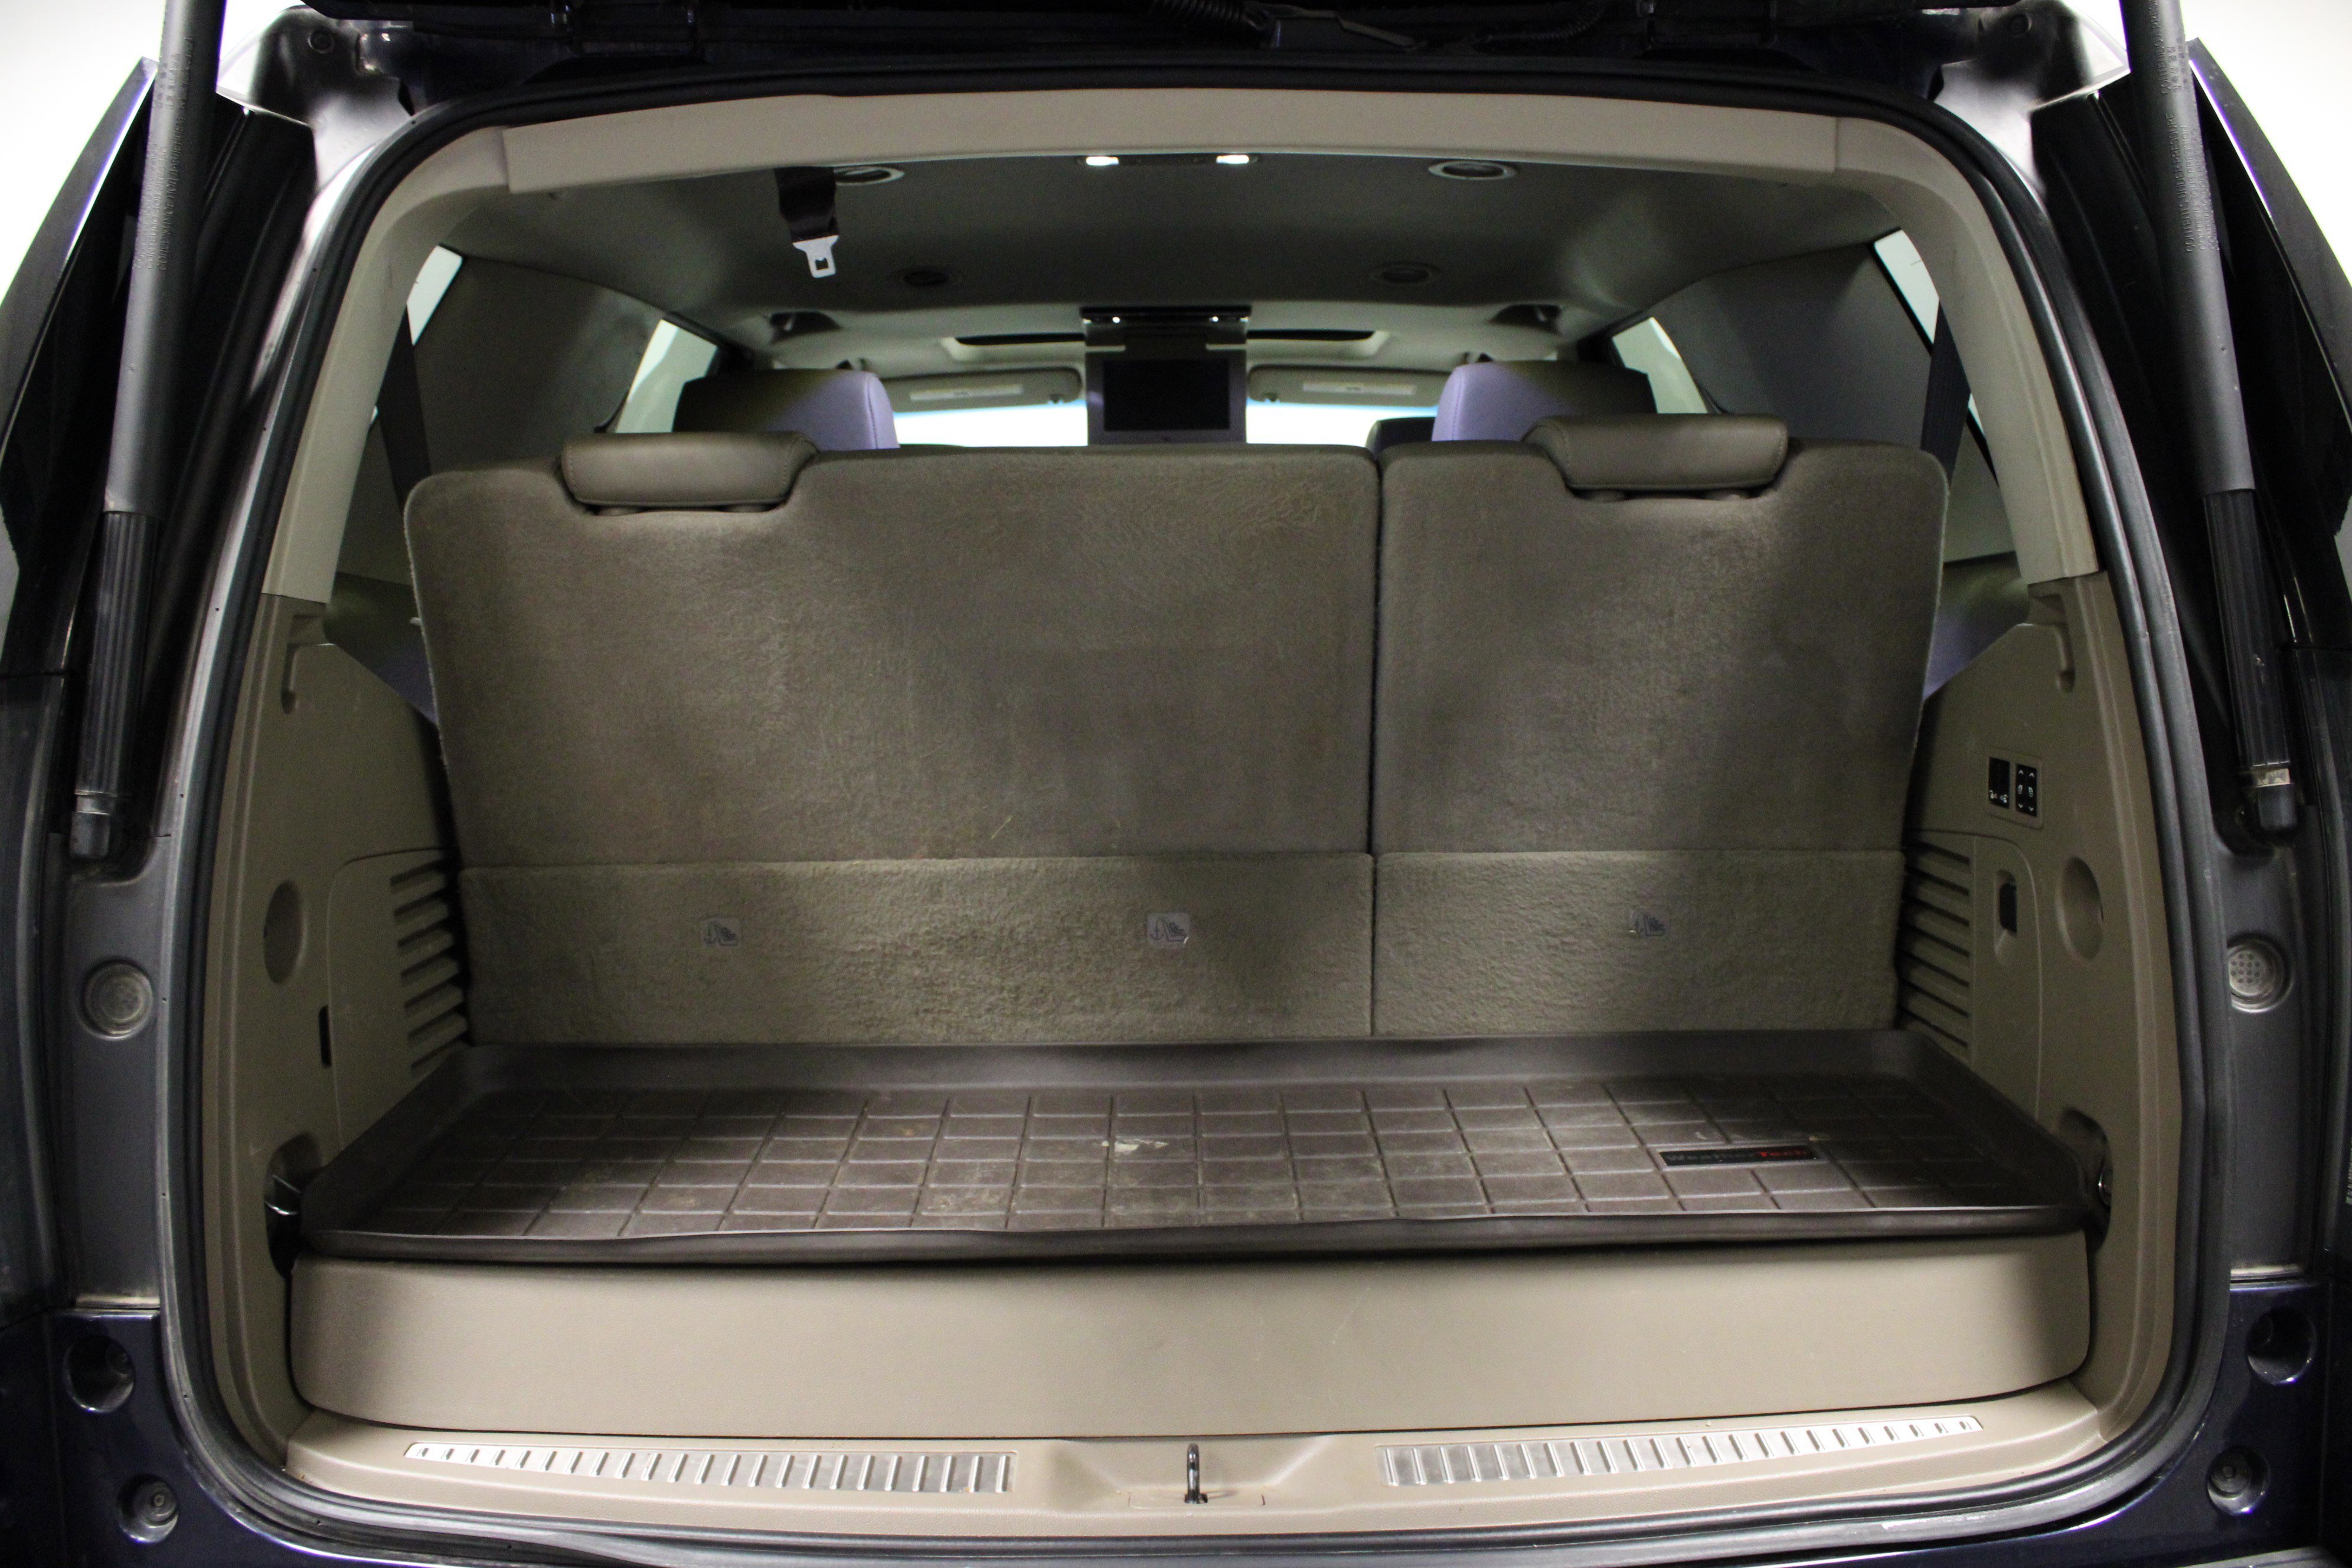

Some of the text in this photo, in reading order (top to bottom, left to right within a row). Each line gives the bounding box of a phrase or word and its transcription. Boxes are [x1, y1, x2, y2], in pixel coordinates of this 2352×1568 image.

[2147, 0, 2161, 29] PRESI
[2164, 112, 2182, 164] PRESSURE
[2180, 125, 2194, 173] PRESSION
[2173, 164, 2187, 198] UNDER
[2178, 199, 2196, 253] CONTENTS
[2191, 204, 2206, 250] CONTENU
